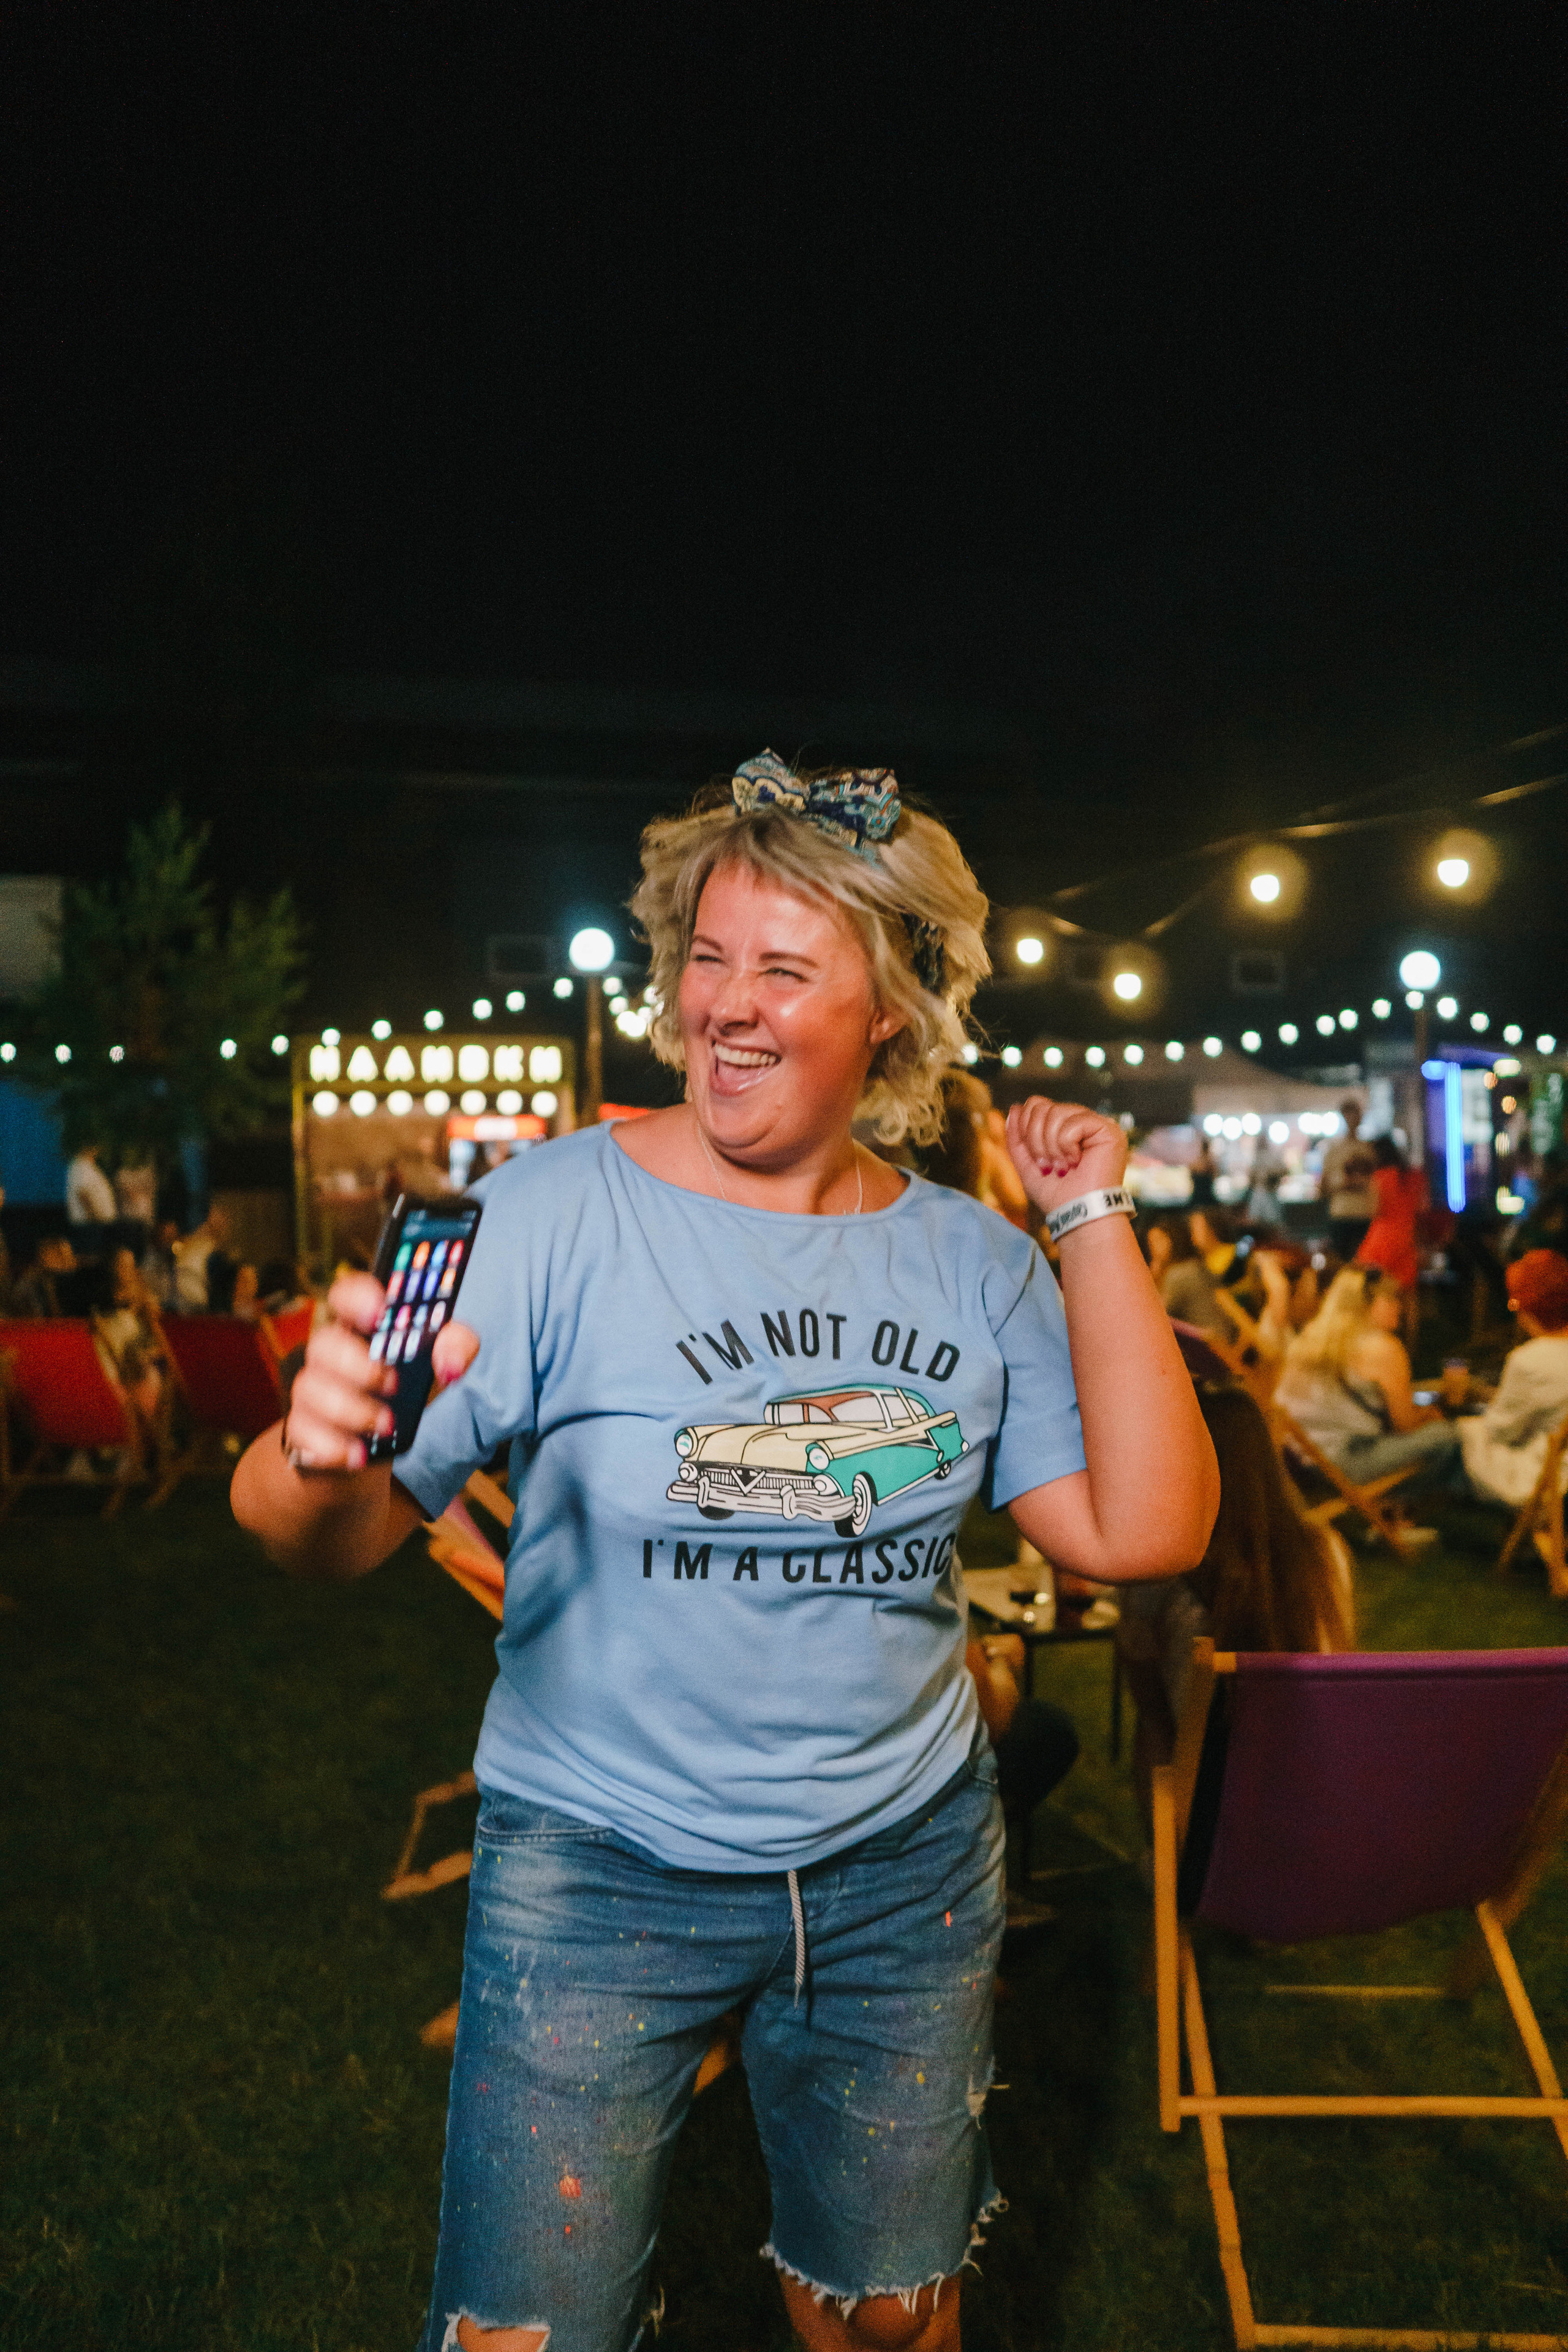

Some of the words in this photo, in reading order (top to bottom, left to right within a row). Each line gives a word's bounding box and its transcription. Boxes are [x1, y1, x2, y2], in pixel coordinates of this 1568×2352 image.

[676, 1319, 755, 1385] I'M
[760, 1308, 847, 1360] NOT
[871, 1319, 960, 1382] OLD
[643, 1539, 713, 1580] I'M
[733, 1546, 759, 1581] A
[782, 1532, 957, 1584] CLASSIC
